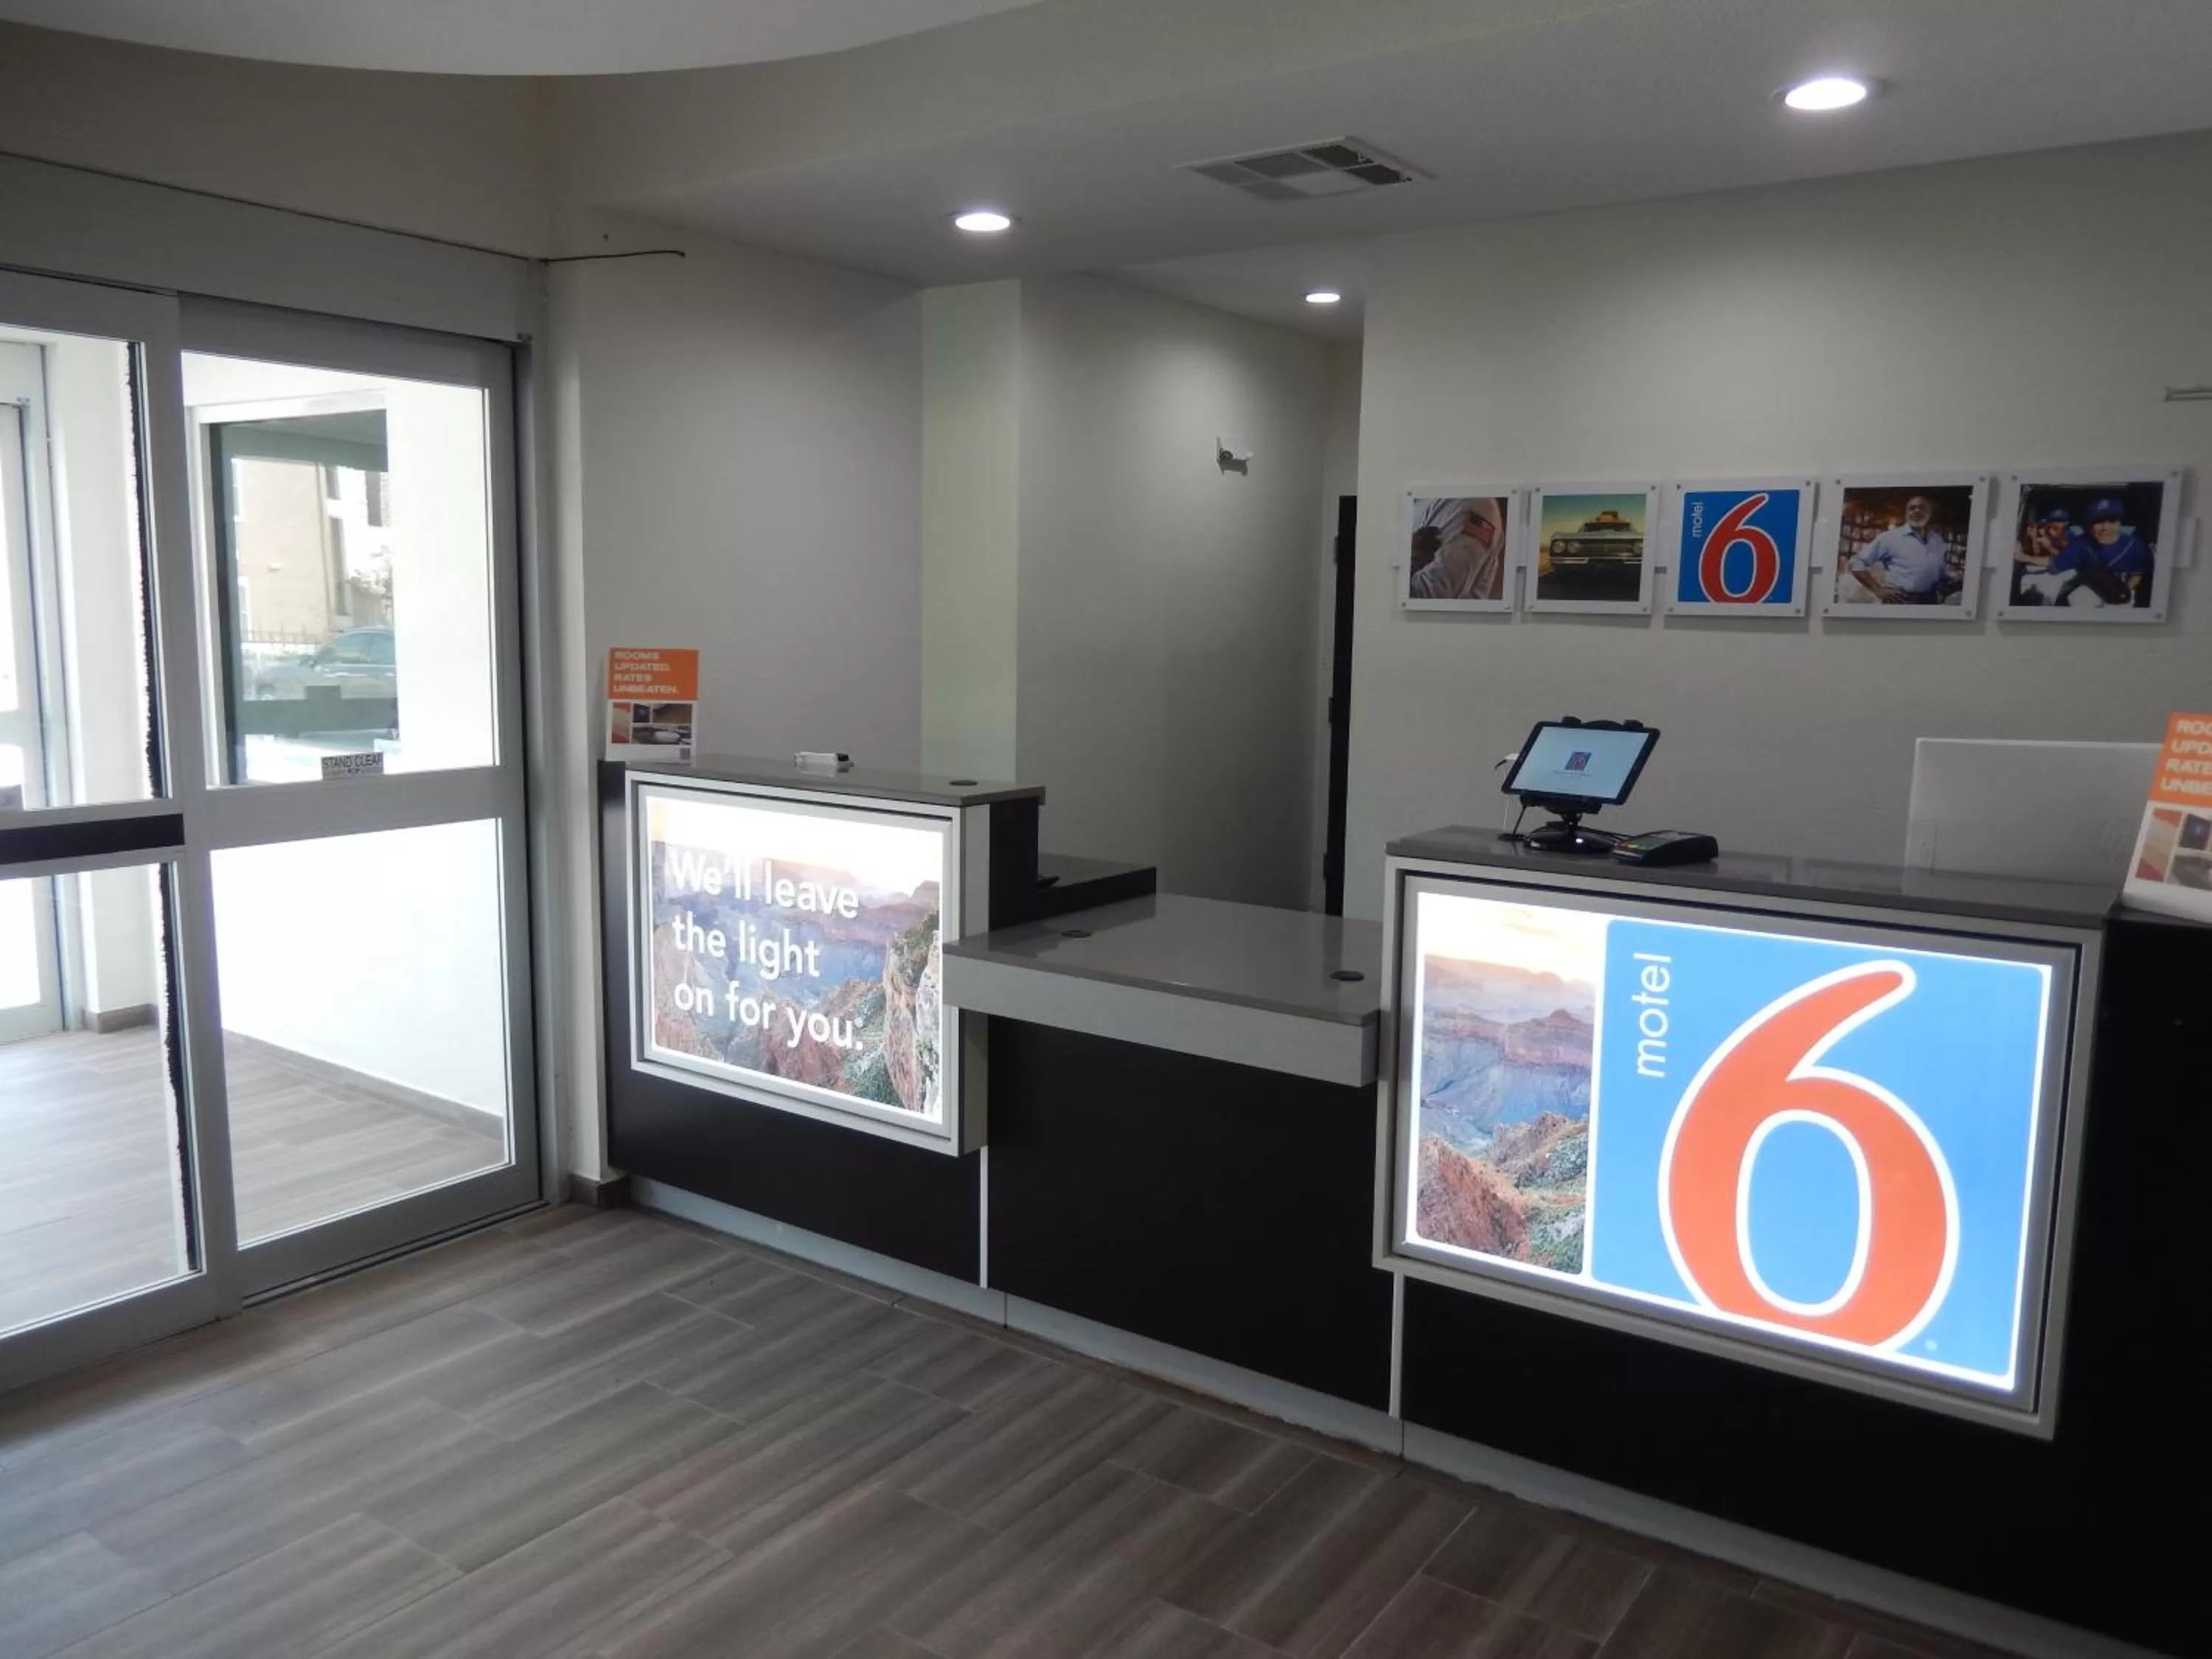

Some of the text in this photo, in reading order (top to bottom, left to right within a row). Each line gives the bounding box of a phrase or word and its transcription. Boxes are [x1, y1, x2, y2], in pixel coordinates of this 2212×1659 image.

[1691, 502, 1704, 538] motel
[1699, 493, 1780, 605] 6
[613, 651, 661, 660] ROOMS
[613, 674, 653, 682] RATES
[323, 756, 352, 768] STAND
[2170, 738, 2212, 755] UPD
[665, 846, 860, 919] We'll leave
[672, 911, 821, 980] the light
[674, 981, 714, 1017] on
[725, 981, 776, 1029] for
[1631, 952, 1672, 1077] motel
[1658, 959, 1961, 1357] 6
